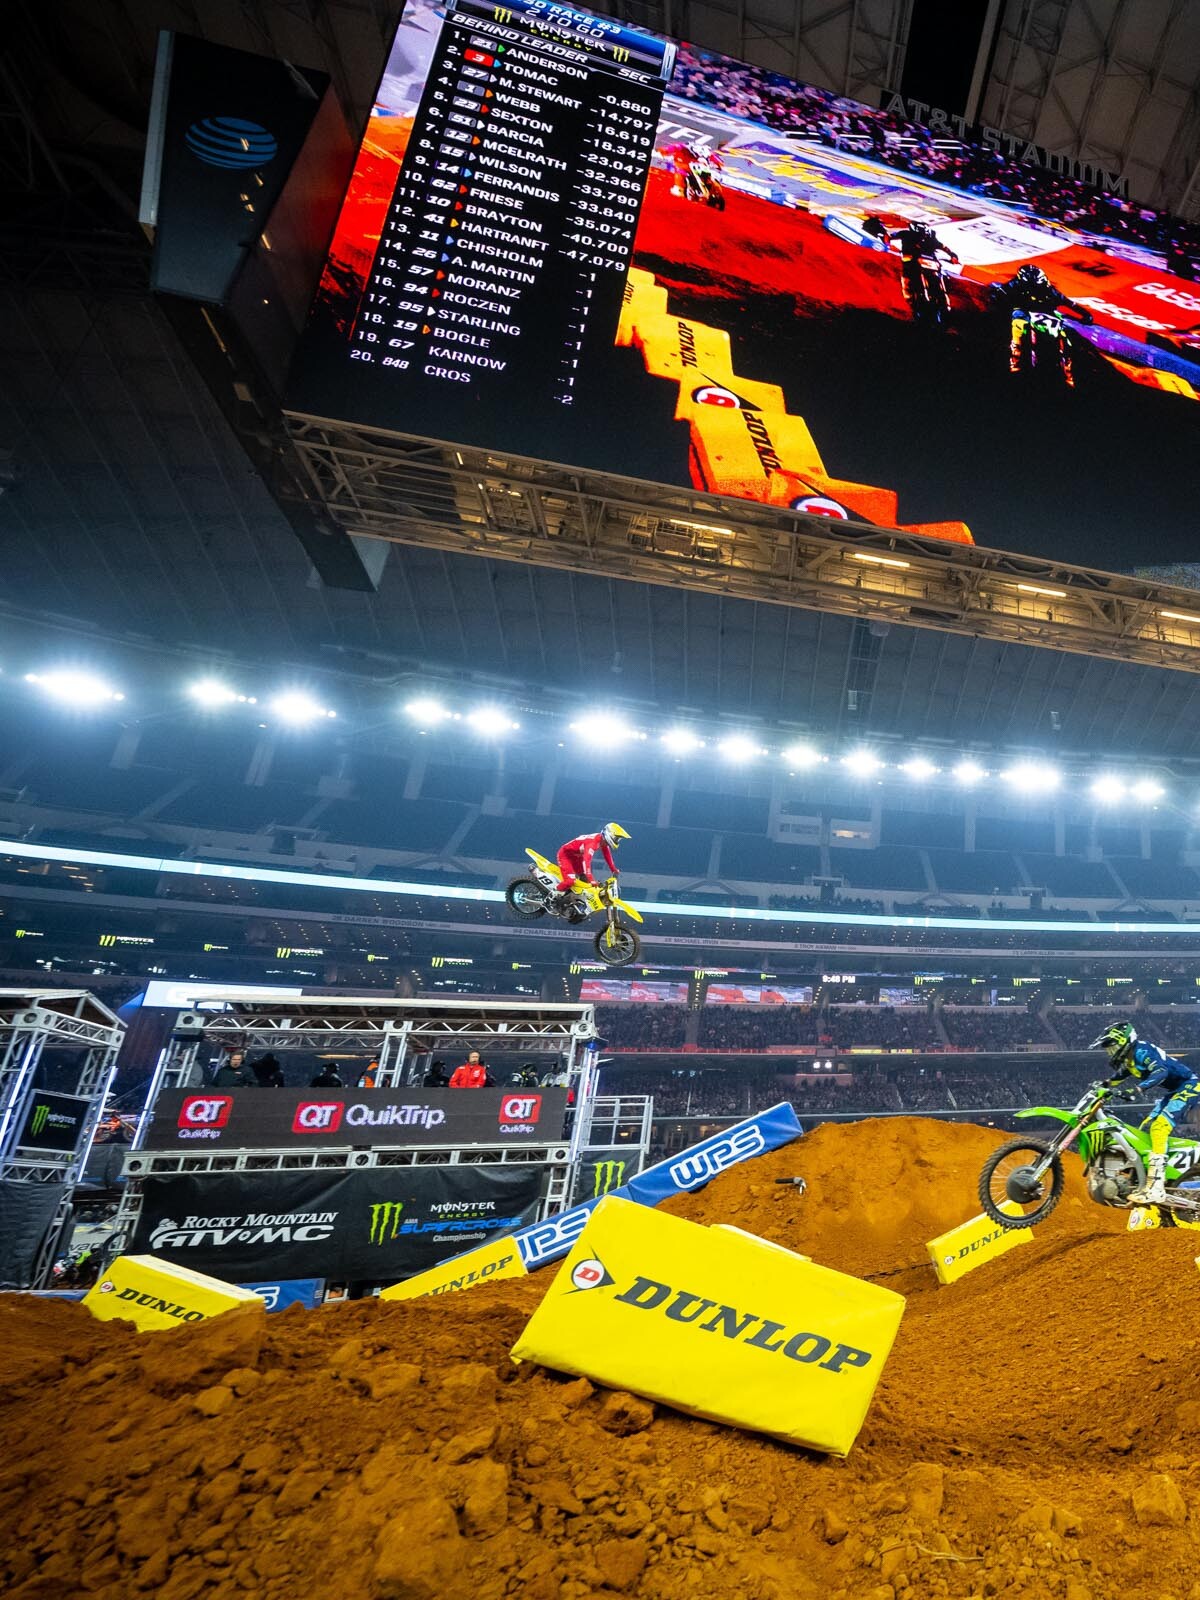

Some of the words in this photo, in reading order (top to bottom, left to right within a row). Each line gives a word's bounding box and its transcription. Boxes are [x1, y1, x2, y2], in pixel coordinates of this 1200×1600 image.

[520, 16, 607, 52] MONSTER
[525, 7, 541, 16] 2
[546, 12, 572, 27] TO
[576, 24, 605, 38] GO
[549, 6, 593, 25] RACE
[597, 22, 622, 34] #3
[452, 14, 520, 40] BEHIND
[520, 36, 589, 64] LEADER
[617, 68, 651, 84] SEC
[454, 30, 466, 41] 1.
[472, 38, 492, 49] 21
[506, 48, 588, 81] ANDERSON
[442, 60, 457, 72] 3.
[463, 67, 489, 80] 27
[517, 82, 583, 109] STEWART
[590, 108, 654, 131] -14.797
[446, 45, 461, 56] 2.
[473, 54, 485, 62] 3
[503, 61, 559, 86] TOMAC
[598, 95, 651, 116] -0.880
[433, 90, 448, 102] 5.
[490, 107, 553, 134] SEXTON
[583, 138, 648, 162] -18.342
[437, 76, 453, 87] 4.
[464, 84, 475, 93] 1
[495, 91, 541, 113] WEBB
[586, 123, 651, 147] -16.619
[887, 93, 974, 137] AT&T
[425, 122, 439, 134] 7.
[446, 130, 469, 142] 12
[482, 138, 567, 171] MCELRATH
[576, 168, 641, 192] -32.366
[428, 106, 444, 118] 6.
[450, 113, 476, 126] 51
[486, 123, 545, 148] BARCIA
[580, 153, 644, 176] -23.047
[415, 155, 430, 167] 9.
[436, 162, 460, 174] 14
[473, 171, 560, 202] FERRANDIS
[569, 200, 635, 224] -33.840
[419, 138, 435, 150] 8.
[441, 146, 467, 160] 15
[479, 154, 542, 181] WILSON
[572, 184, 639, 208] -33.790
[400, 187, 421, 200] 11.
[427, 195, 451, 207] 10
[465, 204, 543, 233] BRAYTON
[562, 233, 629, 255] -40.700
[404, 170, 425, 184] 10.
[432, 179, 457, 191] 62
[469, 187, 524, 210] FRIESE
[565, 216, 631, 240] -35.074
[390, 221, 411, 235] 13.
[419, 230, 440, 241] 11
[456, 238, 544, 268] CHISHOLM
[395, 204, 416, 217] 12.
[423, 213, 445, 225] 41
[461, 221, 550, 251] HARTRANFT
[558, 250, 626, 272] -47.079
[380, 256, 401, 270] 15.
[408, 265, 434, 276] 57
[447, 273, 522, 299] MORANZ
[385, 239, 406, 252] 14.
[412, 247, 437, 259] 26
[470, 260, 535, 284] MARTIN
[369, 293, 391, 306] 17.
[398, 301, 424, 313] 95
[437, 309, 521, 336] STARLING
[375, 275, 396, 288] 16.
[403, 283, 428, 295] 94
[443, 290, 511, 315] ROCZEN
[359, 330, 380, 344] 19.
[388, 338, 415, 349] 67
[428, 345, 507, 371] KARNOW
[364, 311, 386, 325] 18.
[393, 320, 418, 331] 19
[433, 327, 491, 349] BOGLE
[350, 349, 375, 363] 20.
[382, 357, 410, 369] 848
[424, 365, 471, 383] CROS
[538, 875, 553, 885] 19
[185, 1100, 226, 1123] QT
[299, 1104, 338, 1128] QT
[504, 1098, 537, 1119] QT
[669, 1124, 765, 1189] WPS
[1174, 1151, 1195, 1169] 21
[180, 1215, 242, 1229] ROCKY
[242, 1212, 339, 1228] MOUNTAIN
[399, 1216, 522, 1235] SUPERCROSS
[430, 1201, 496, 1213] MONSTER
[432, 1231, 487, 1242] Championship
[958, 1226, 1012, 1259] DUNL
[115, 1286, 211, 1323] DUNLO
[613, 1275, 873, 1374] DUNLOP
